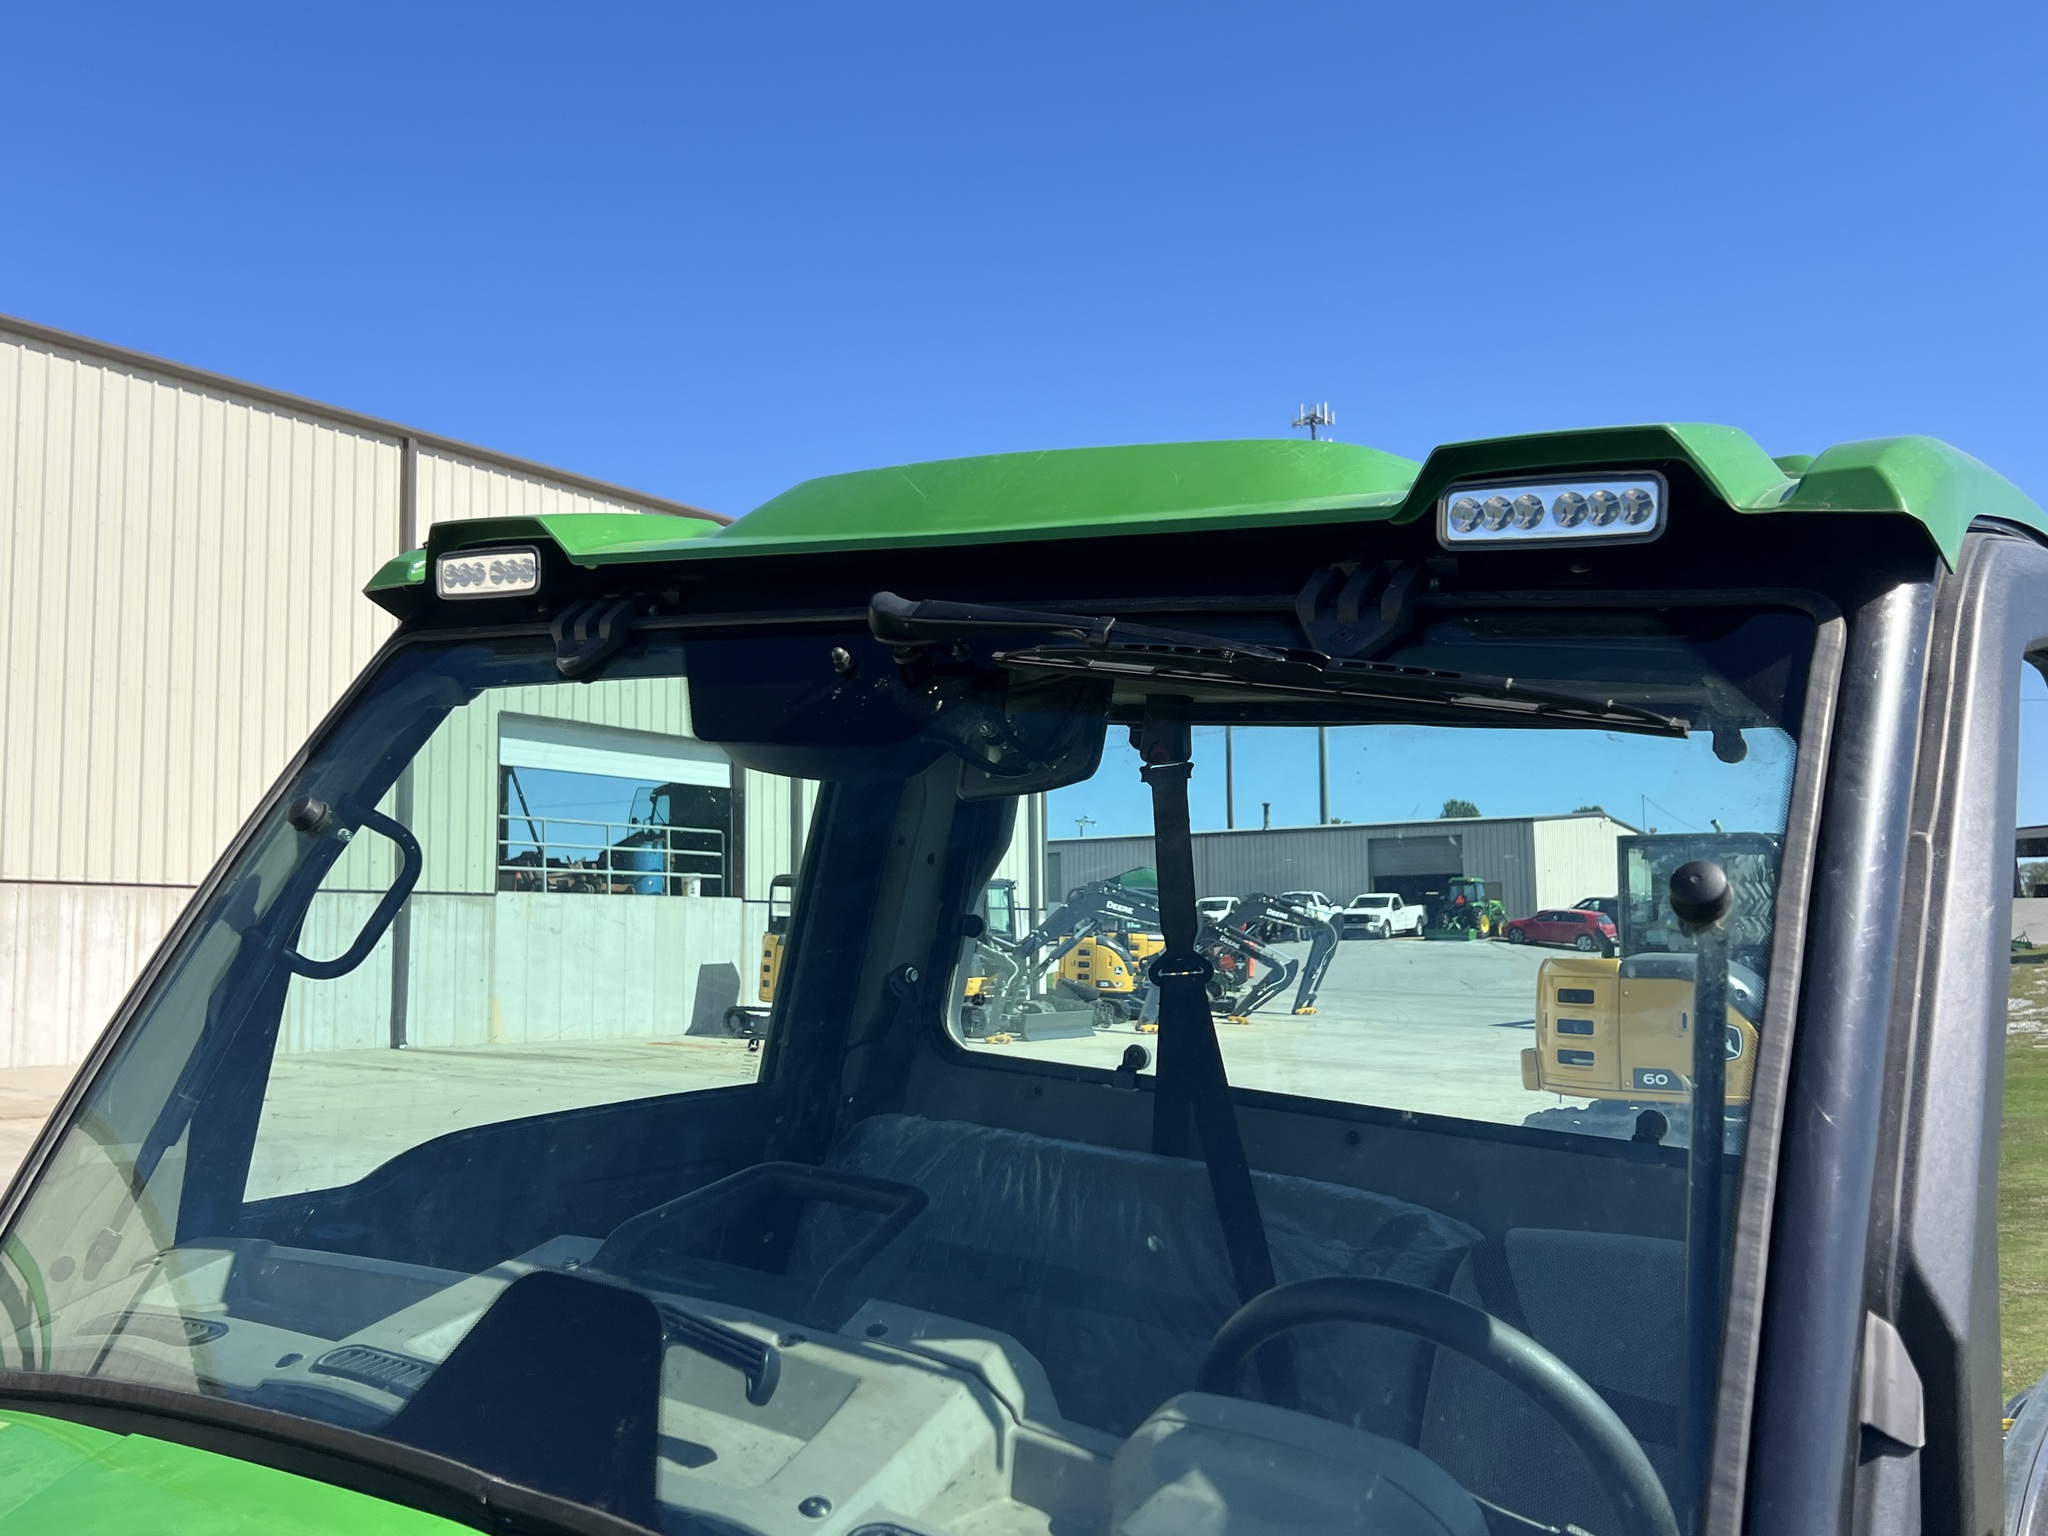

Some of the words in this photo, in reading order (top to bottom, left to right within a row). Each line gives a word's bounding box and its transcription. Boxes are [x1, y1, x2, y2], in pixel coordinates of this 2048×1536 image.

[1106, 900, 1134, 914] DEERE
[1266, 908, 1288, 919] DEERE
[1220, 935, 1240, 949] DEERE
[1642, 1073, 1669, 1086] 60
